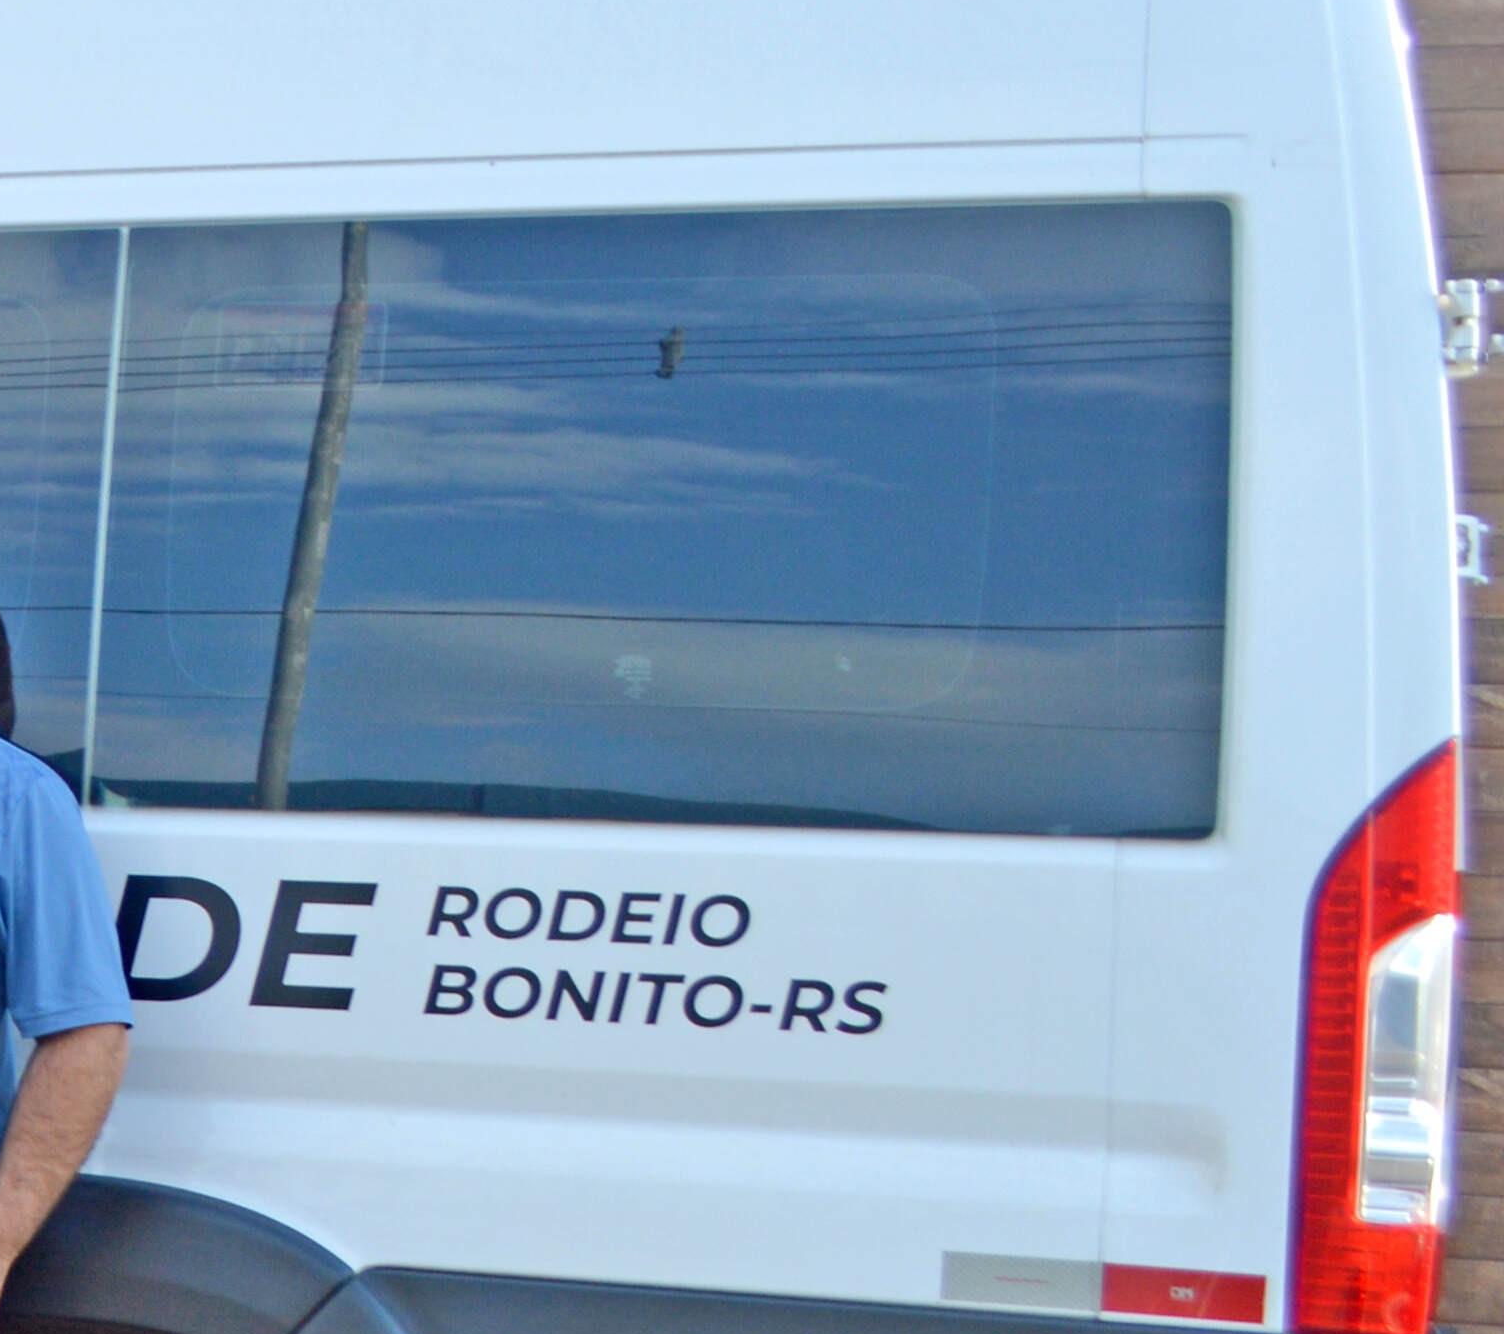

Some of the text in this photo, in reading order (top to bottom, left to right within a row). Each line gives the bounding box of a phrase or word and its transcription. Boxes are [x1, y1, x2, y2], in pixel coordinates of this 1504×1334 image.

[115, 873, 379, 1011] DE
[426, 884, 752, 948] RODEIO
[422, 963, 888, 1036] BONITO-RS
